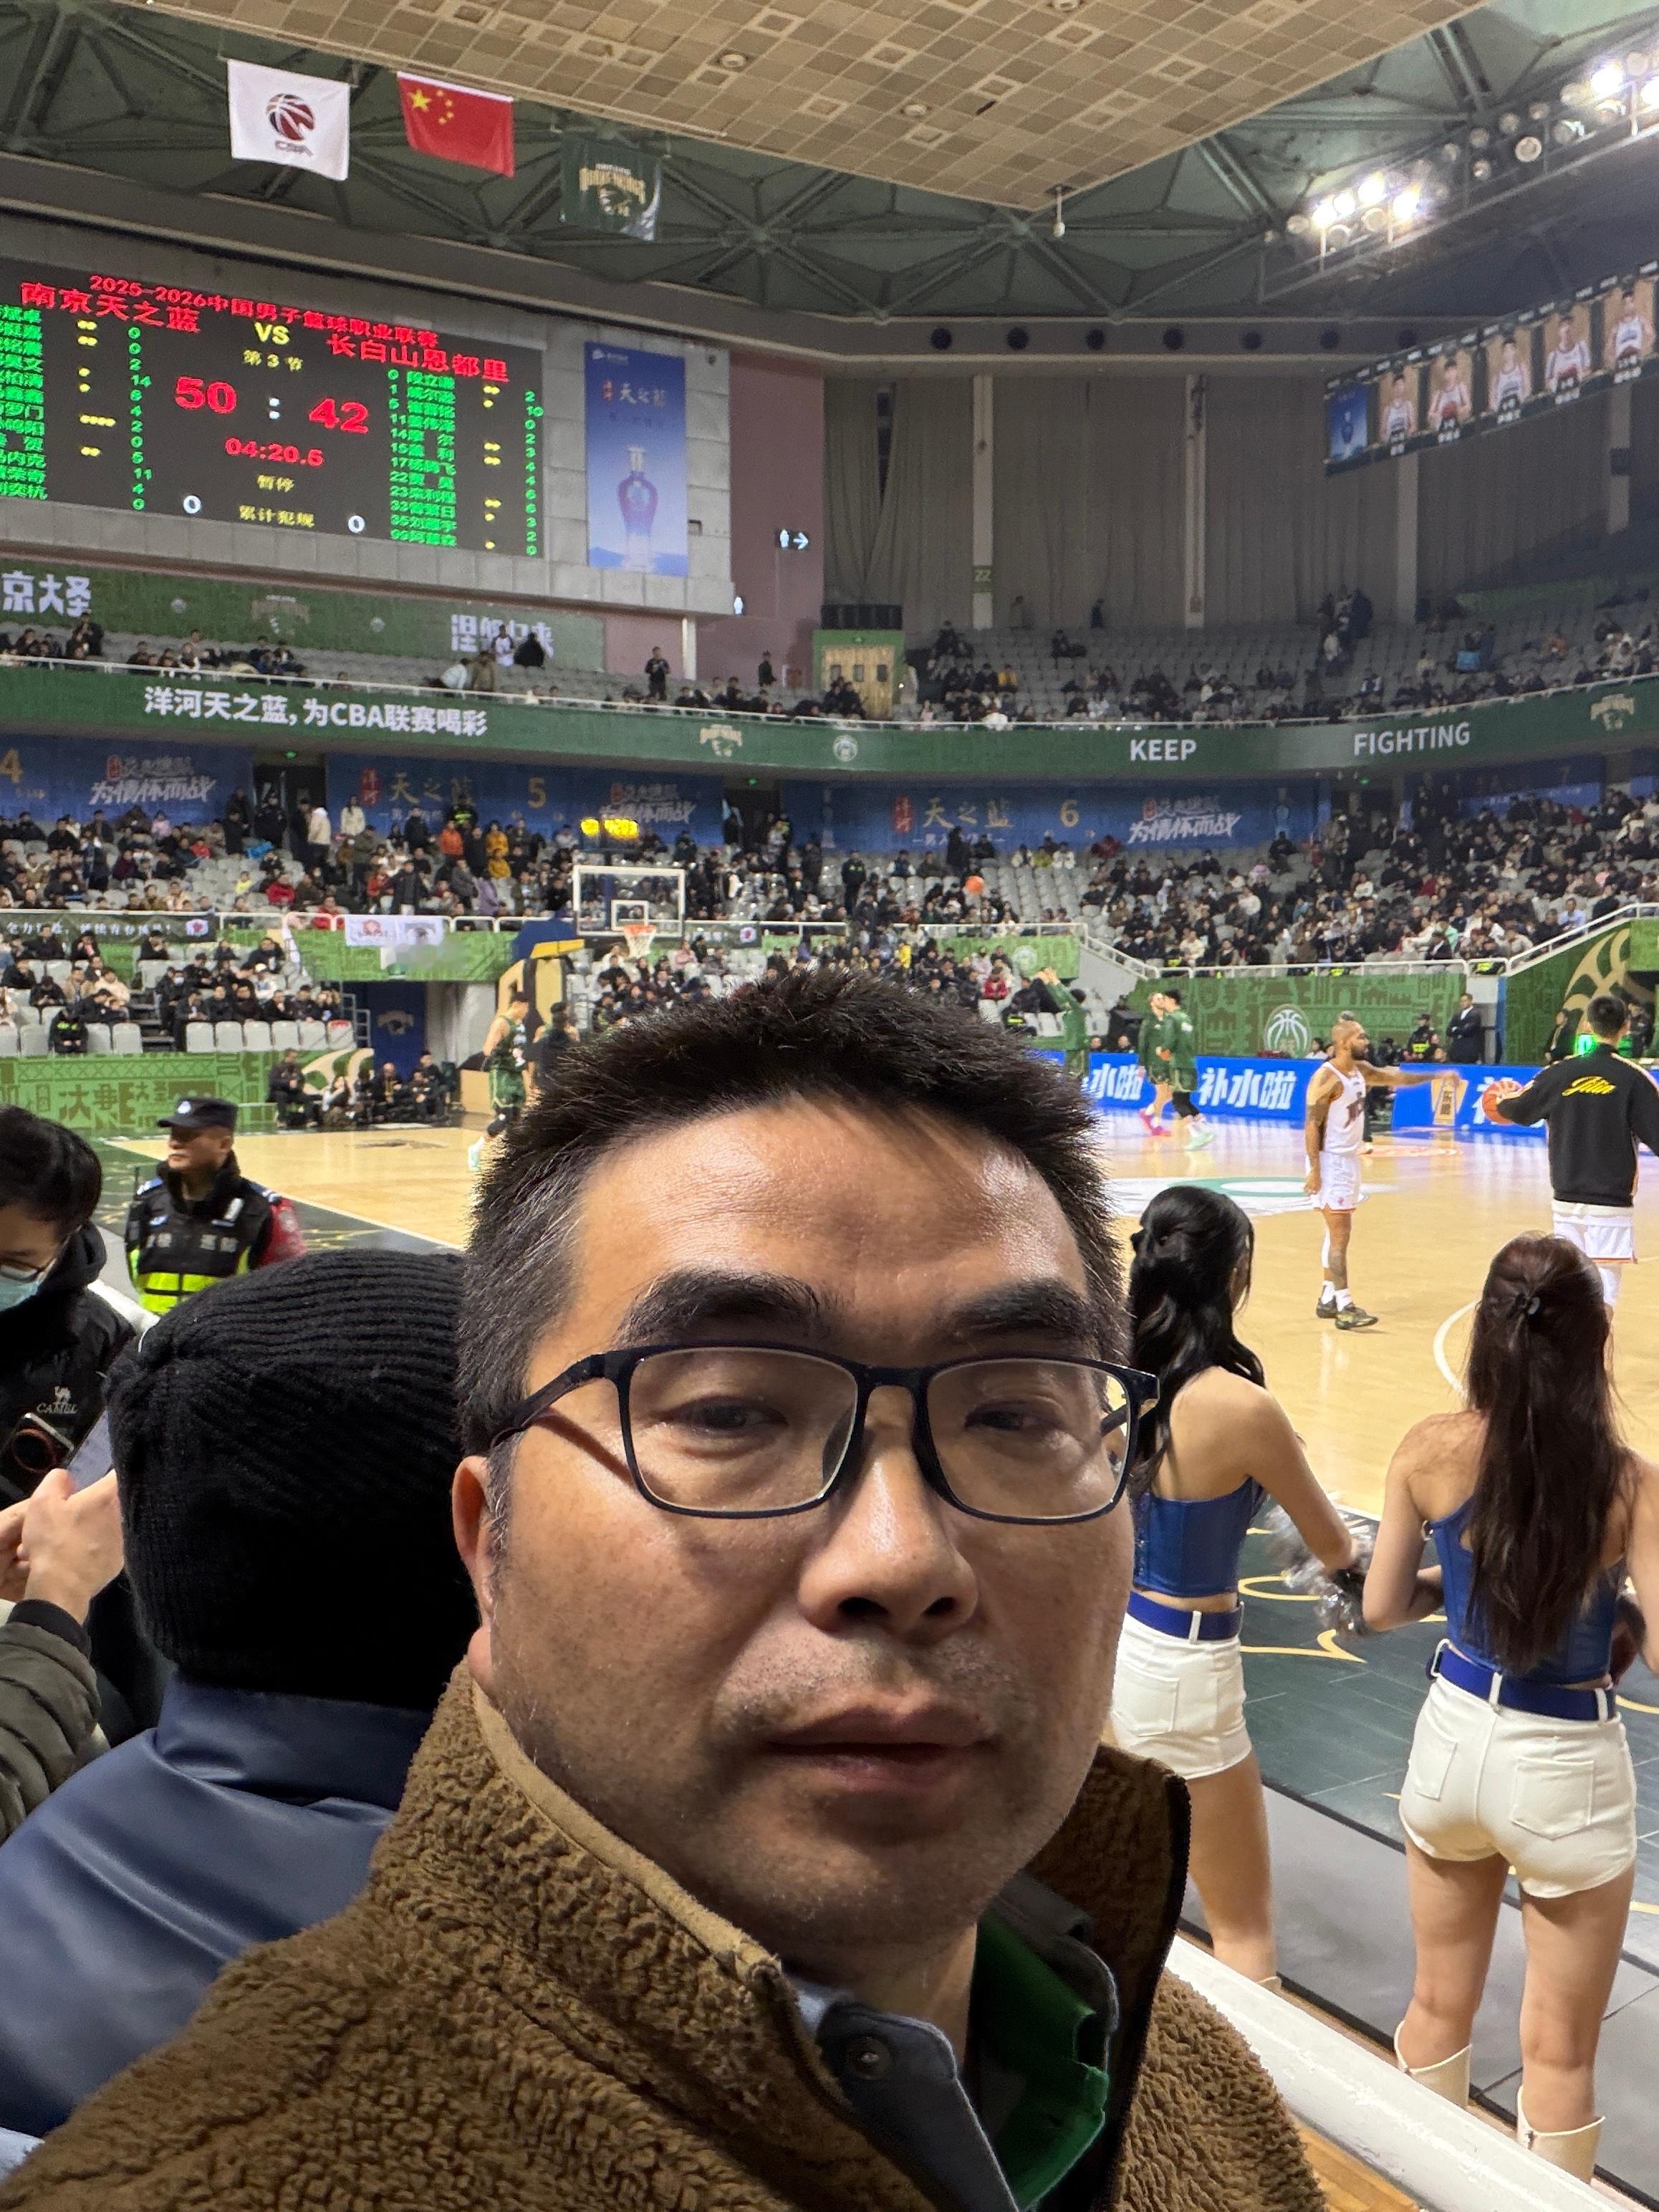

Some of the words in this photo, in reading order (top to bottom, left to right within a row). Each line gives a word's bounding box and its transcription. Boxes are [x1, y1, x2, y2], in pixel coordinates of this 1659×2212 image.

[21, 282, 201, 333] 南京天之蓝
[254, 322, 290, 345] VS
[129, 358, 142, 371] 2
[327, 333, 511, 383] 长白山恩都里
[131, 375, 152, 388] 14
[390, 384, 398, 395] 1
[174, 376, 237, 414] 50
[309, 398, 369, 434] 42
[526, 405, 544, 417] 10
[130, 420, 143, 433] 2
[390, 413, 406, 425] 11
[134, 468, 153, 481] 11
[256, 474, 294, 492] 暂停
[133, 483, 144, 494] 4
[133, 498, 145, 510] 0
[183, 494, 202, 514] 0
[239, 504, 315, 528] 累计犯规
[347, 514, 366, 534] 0
[1130, 739, 1197, 761] KEEP
[1354, 722, 1471, 756] FIGHTING
[0, 748, 23, 784] 4
[528, 776, 547, 808] 5
[1059, 799, 1079, 827] 6
[1079, 1063, 1146, 1101] 水啦
[1198, 1067, 1297, 1110] 补水啦
